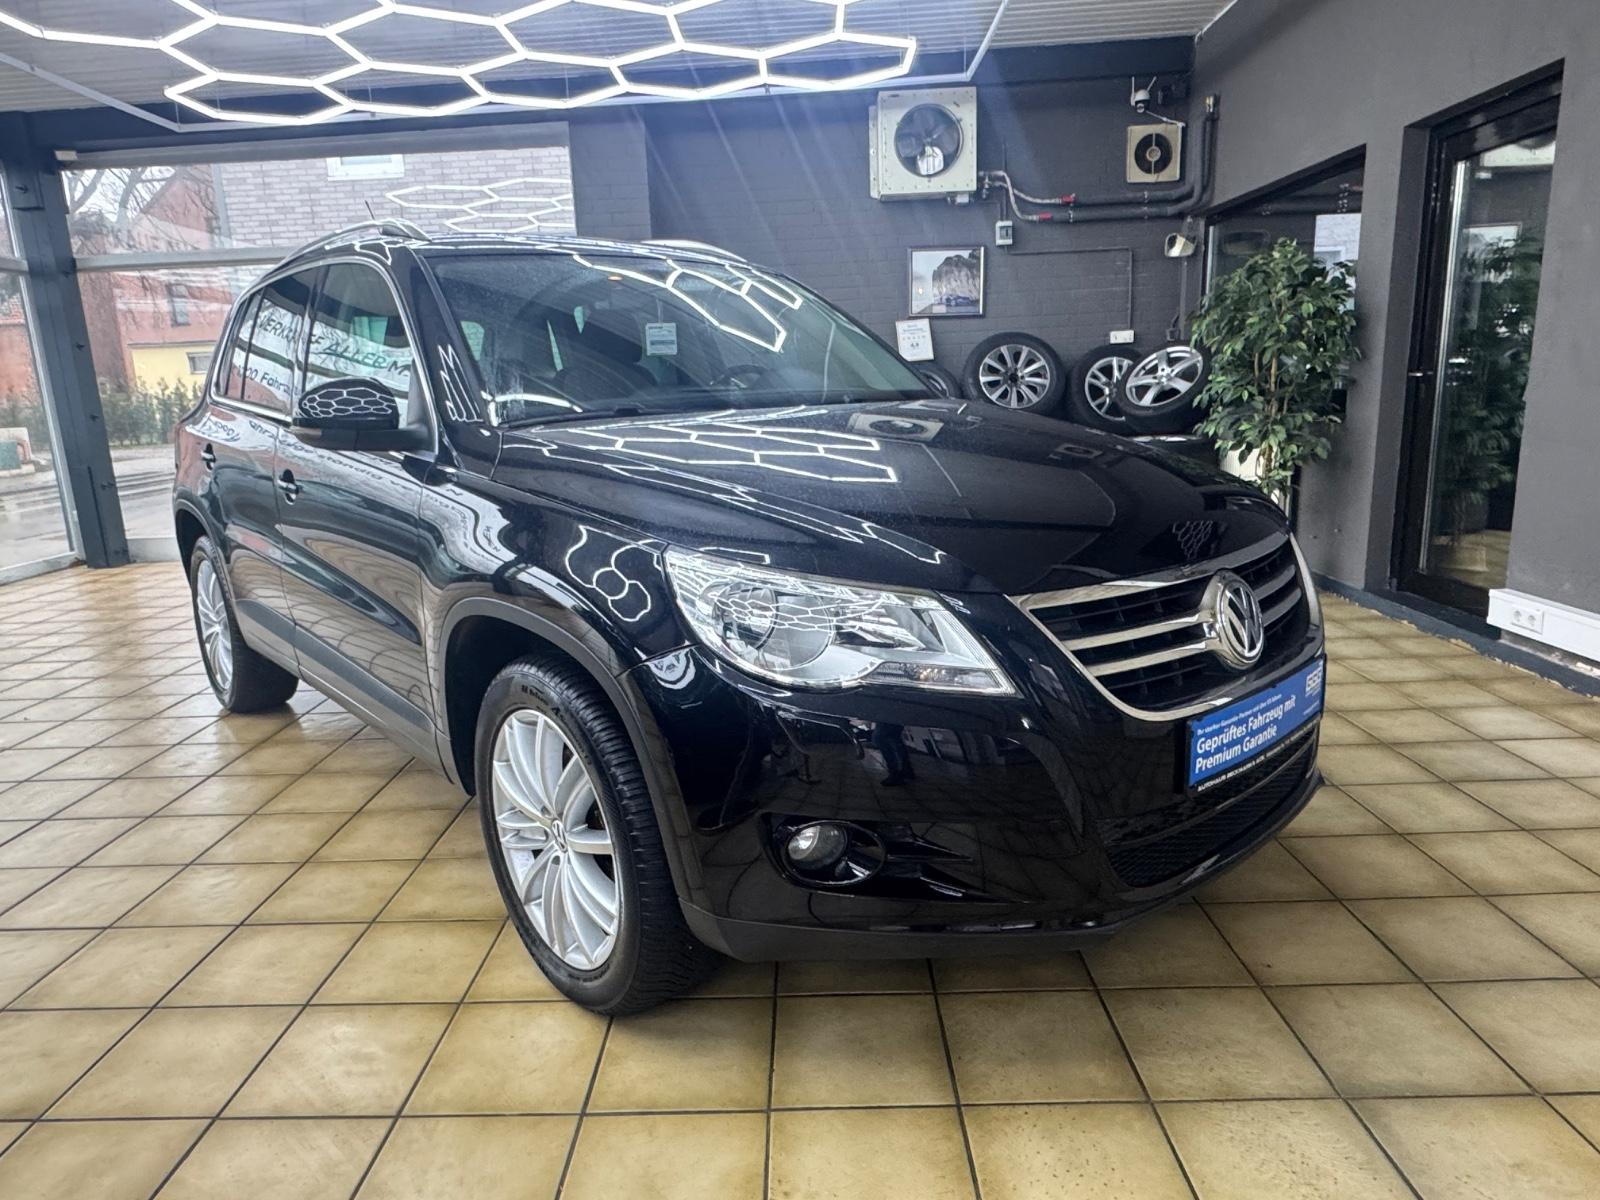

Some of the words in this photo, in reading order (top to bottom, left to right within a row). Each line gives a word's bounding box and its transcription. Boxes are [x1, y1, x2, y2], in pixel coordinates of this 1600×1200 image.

[1194, 745, 1242, 774] Premium
[1242, 723, 1278, 753] Garantie
[1197, 723, 1247, 755] Geprüftes
[1247, 704, 1284, 733] Fahrzeug
[1283, 694, 1297, 713] mit
